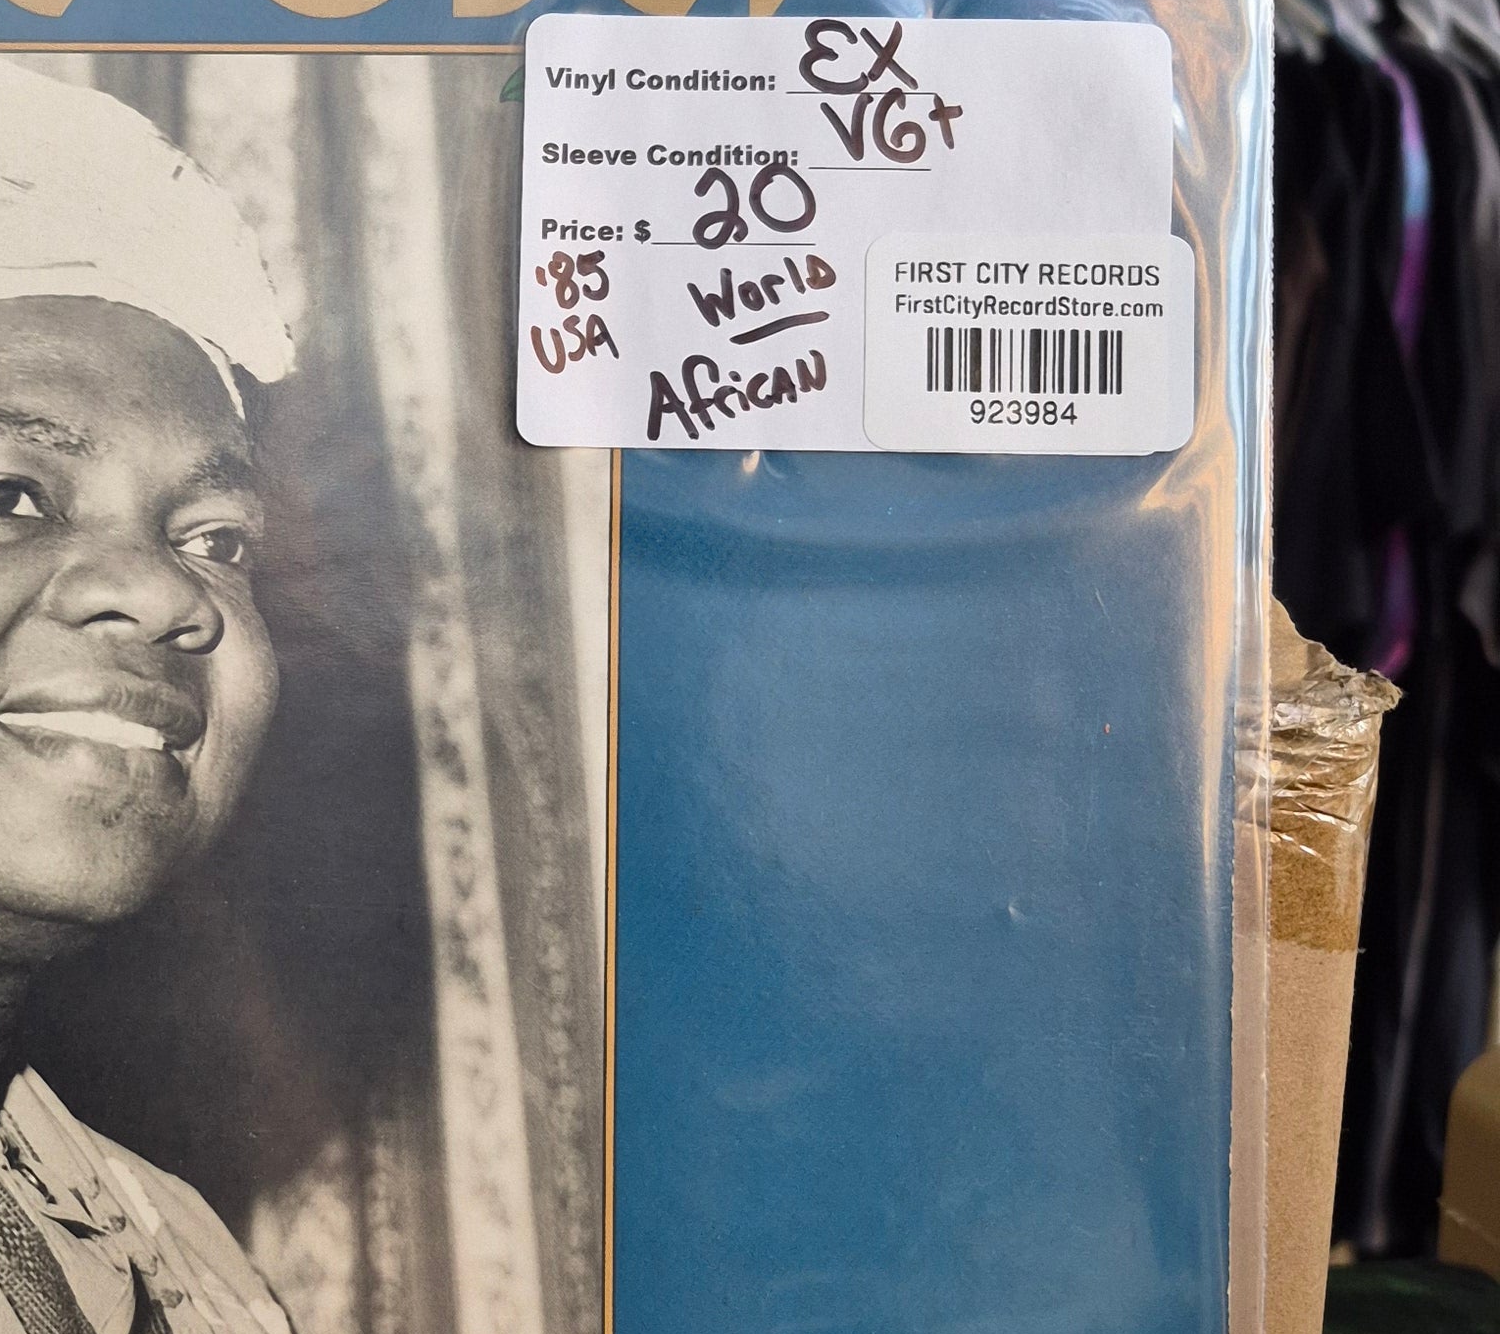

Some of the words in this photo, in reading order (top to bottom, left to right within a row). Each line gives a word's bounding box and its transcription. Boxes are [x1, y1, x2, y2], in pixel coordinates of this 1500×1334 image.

[799, 19, 919, 94] EX
[546, 67, 616, 96] Vinyl
[626, 69, 776, 92] Condition:
[820, 89, 964, 165] VG+
[542, 143, 638, 166] Sleeve
[647, 145, 799, 167] Condition:
[542, 219, 624, 244] Price:
[692, 163, 817, 249] 20
[895, 261, 968, 284] FIRST
[976, 262, 1030, 285] CITY
[1039, 263, 1160, 287] RECORDS
[895, 294, 1164, 319] FirstCityRecordStore.com
[530, 313, 620, 375] USA
[970, 399, 1078, 426] 923984
